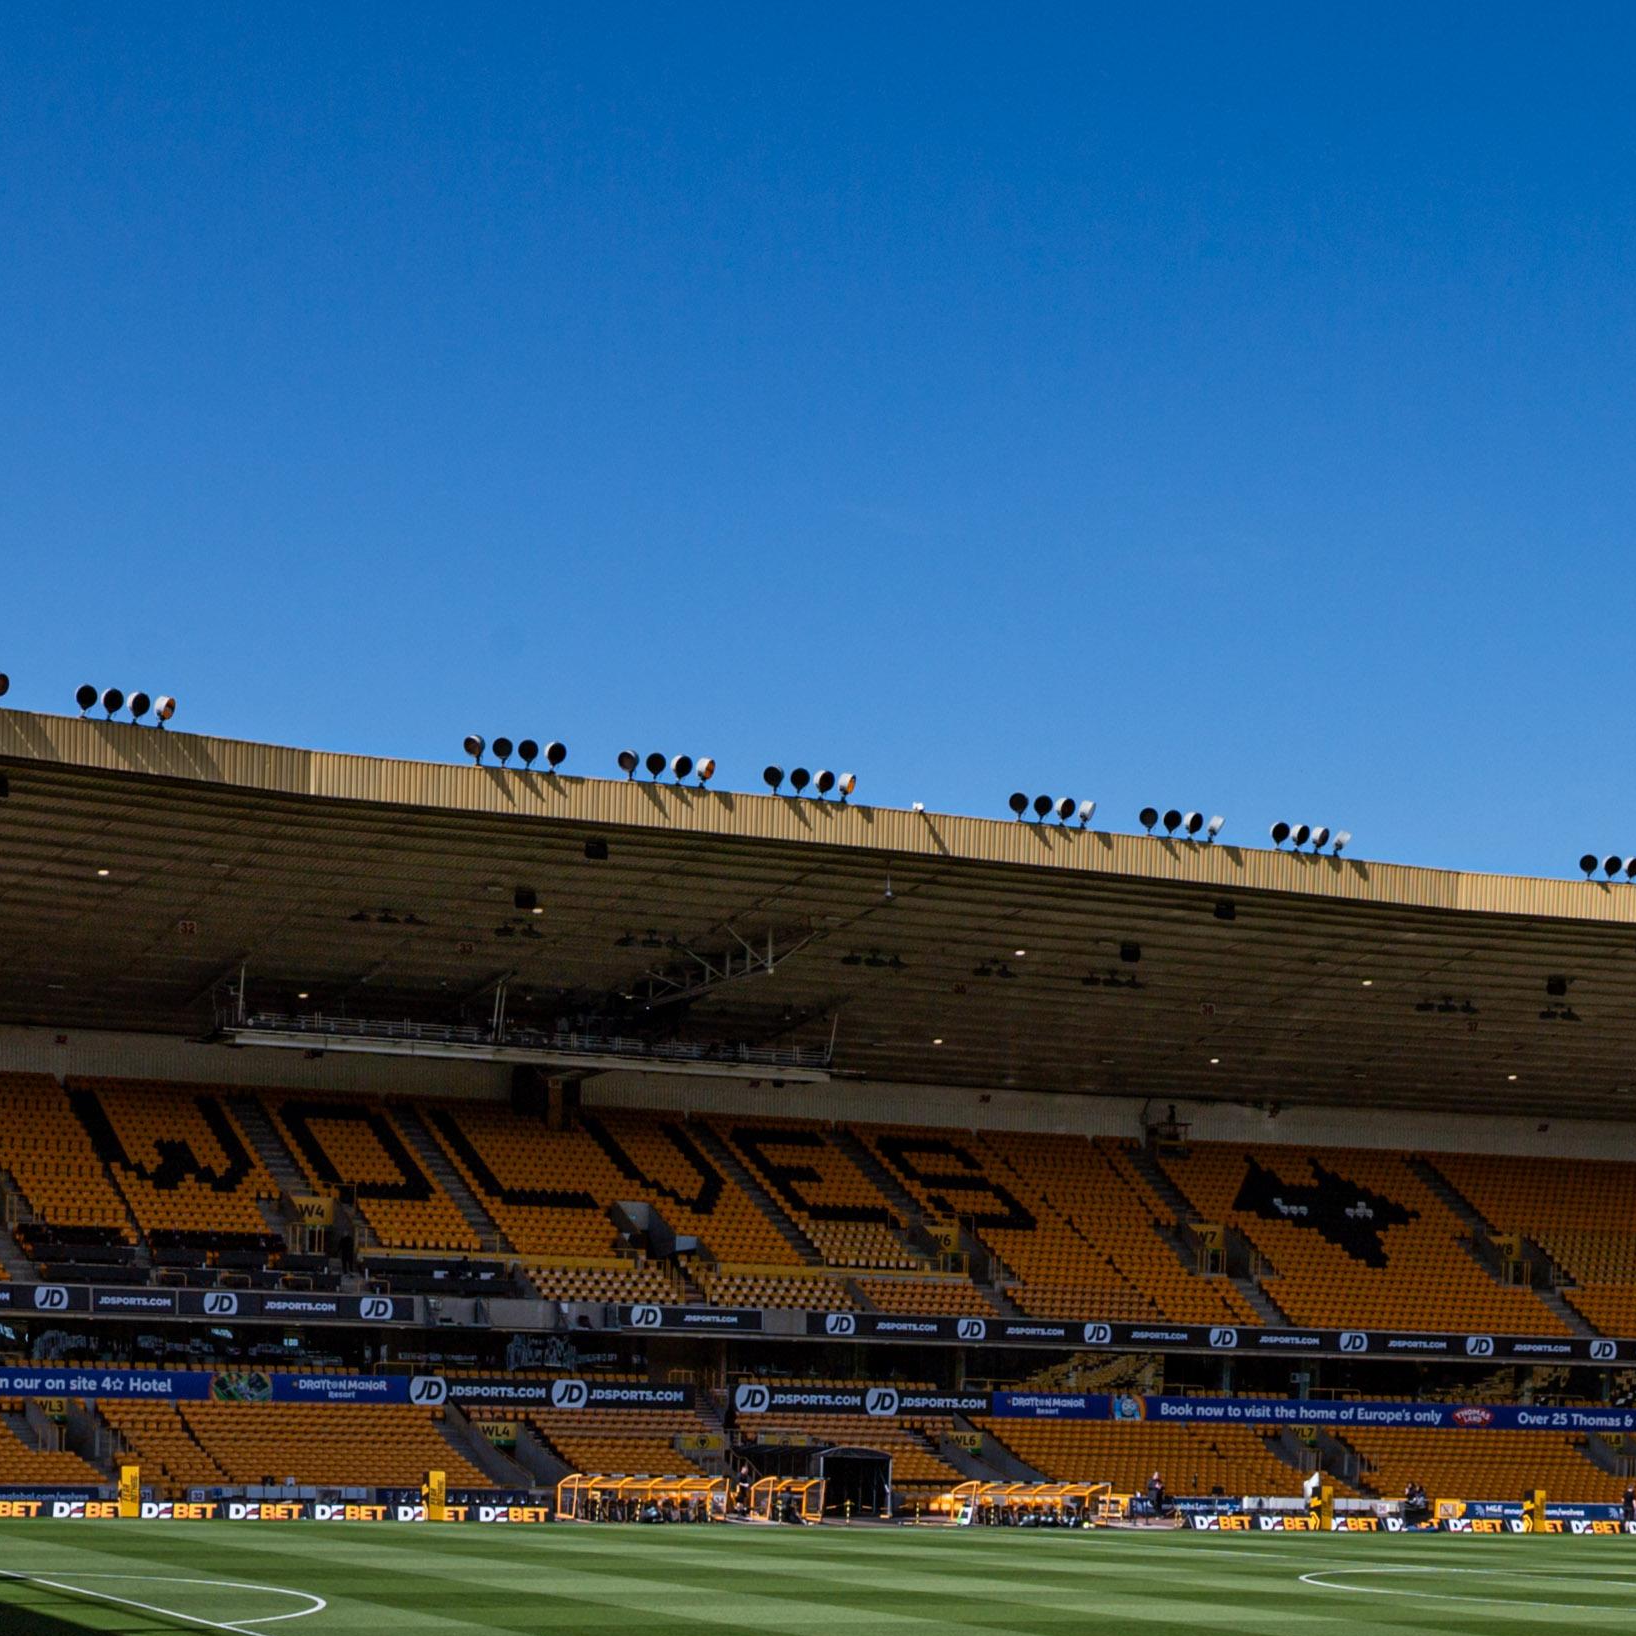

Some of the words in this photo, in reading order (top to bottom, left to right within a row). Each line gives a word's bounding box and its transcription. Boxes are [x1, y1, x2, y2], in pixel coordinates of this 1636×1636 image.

[180, 922, 195, 935] 32
[459, 944, 473, 955] 33
[65, 1089, 1038, 1231] WOLVES
[299, 1204, 324, 1218] W4
[39, 1288, 65, 1307] JD
[98, 1295, 171, 1307] JDSPORTS.COM
[208, 1294, 233, 1312] JD
[264, 1301, 336, 1312] JDSPORTS.COM
[363, 1300, 389, 1318] JD
[635, 1307, 658, 1325] JD
[683, 1314, 738, 1324] JDSPORTS.COM
[829, 1316, 851, 1332] JD
[875, 1321, 938, 1332] JDSPORTS.COM
[962, 1321, 982, 1336] JD
[1006, 1326, 1064, 1337] JDSPORTS.COM
[1088, 1325, 1108, 1341] JD
[1214, 1329, 1234, 1345] JD
[1344, 1334, 1365, 1350] JD
[1470, 1338, 1490, 1354] JD
[1594, 1342, 1613, 1358] JD
[13, 1377, 40, 1389] our
[45, 1377, 65, 1390] on
[69, 1377, 97, 1390] site
[129, 1378, 172, 1392] Hotel
[416, 1380, 443, 1400] JD
[448, 1385, 547, 1398] JDSPORTS.COM
[558, 1384, 584, 1403] JD
[589, 1388, 685, 1402] JDSPORTS.COM
[740, 1389, 765, 1408] JD
[771, 1393, 861, 1406] JDSPORTS.COM
[870, 1392, 895, 1411] JD
[901, 1396, 987, 1409] JDSPORTS.COM
[1161, 1402, 1193, 1416] Book
[1196, 1405, 1224, 1416] now
[1228, 1404, 1242, 1417] to
[1244, 1404, 1271, 1418] visit
[1274, 1407, 1296, 1419] the
[1299, 1407, 1337, 1421] home
[1340, 1408, 1355, 1420] of
[1357, 1409, 1412, 1425] Europe's
[1414, 1411, 1442, 1424] only
[1456, 1408, 1492, 1421] THOMAS
[1517, 1412, 1549, 1425] Over
[1552, 1413, 1568, 1425] 25
[1571, 1413, 1621, 1427] Thomas
[1624, 1416, 1634, 1428] &
[482, 1424, 510, 1438] WL4
[141, 1502, 218, 1519] DEBET
[229, 1503, 304, 1520] DEBET
[314, 1504, 388, 1520] DEBET
[479, 1506, 549, 1522] DEBET
[1194, 1515, 1252, 1530] DEBET
[1449, 1519, 1502, 1533] DEBET
[1571, 1520, 1621, 1534] DEBET
